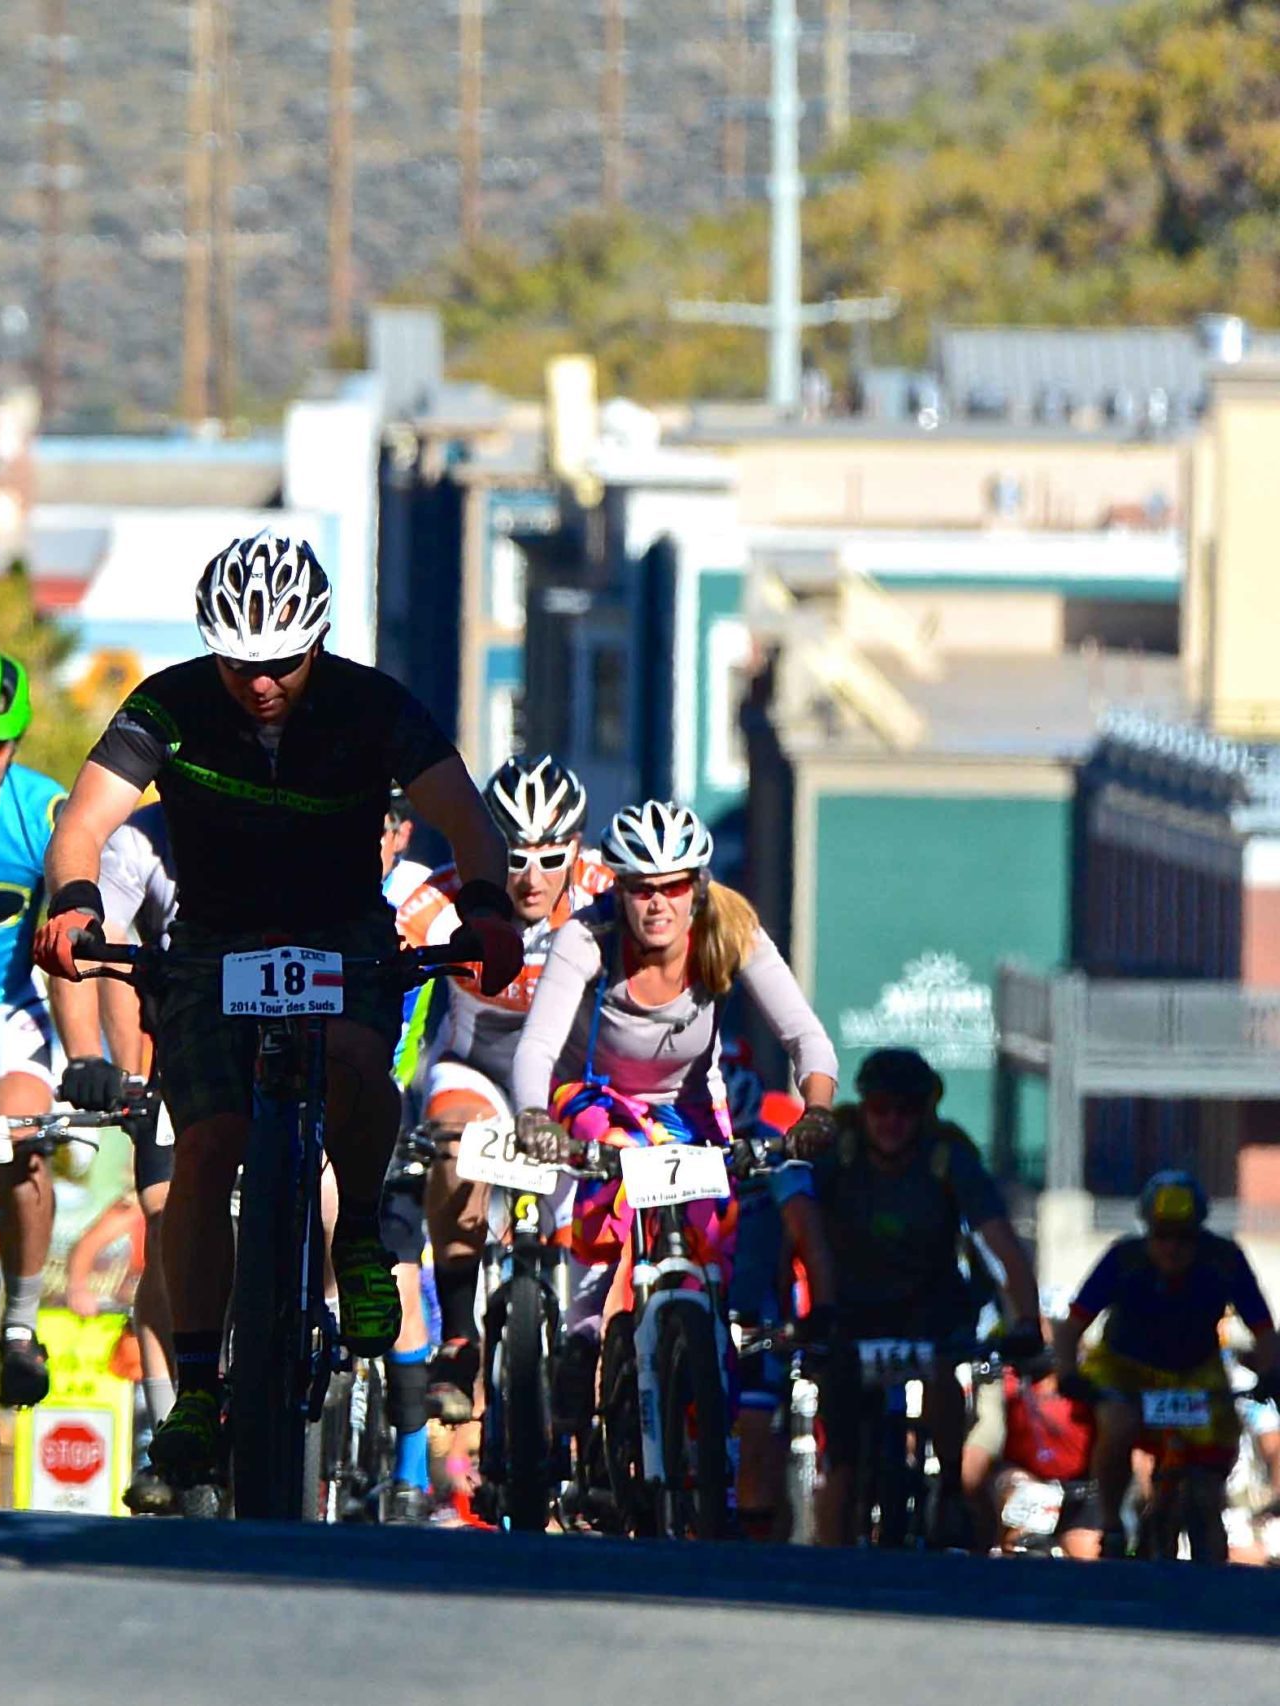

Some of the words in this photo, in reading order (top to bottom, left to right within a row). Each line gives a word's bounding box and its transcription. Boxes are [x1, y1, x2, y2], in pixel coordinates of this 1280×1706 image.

[260, 961, 306, 997] 18
[230, 1001, 258, 1014] 2014
[261, 1001, 284, 1014] Tour
[286, 1001, 306, 1014] des
[308, 1000, 336, 1013] Suds
[663, 1157, 681, 1186] 7
[42, 1440, 102, 1470] STOP
